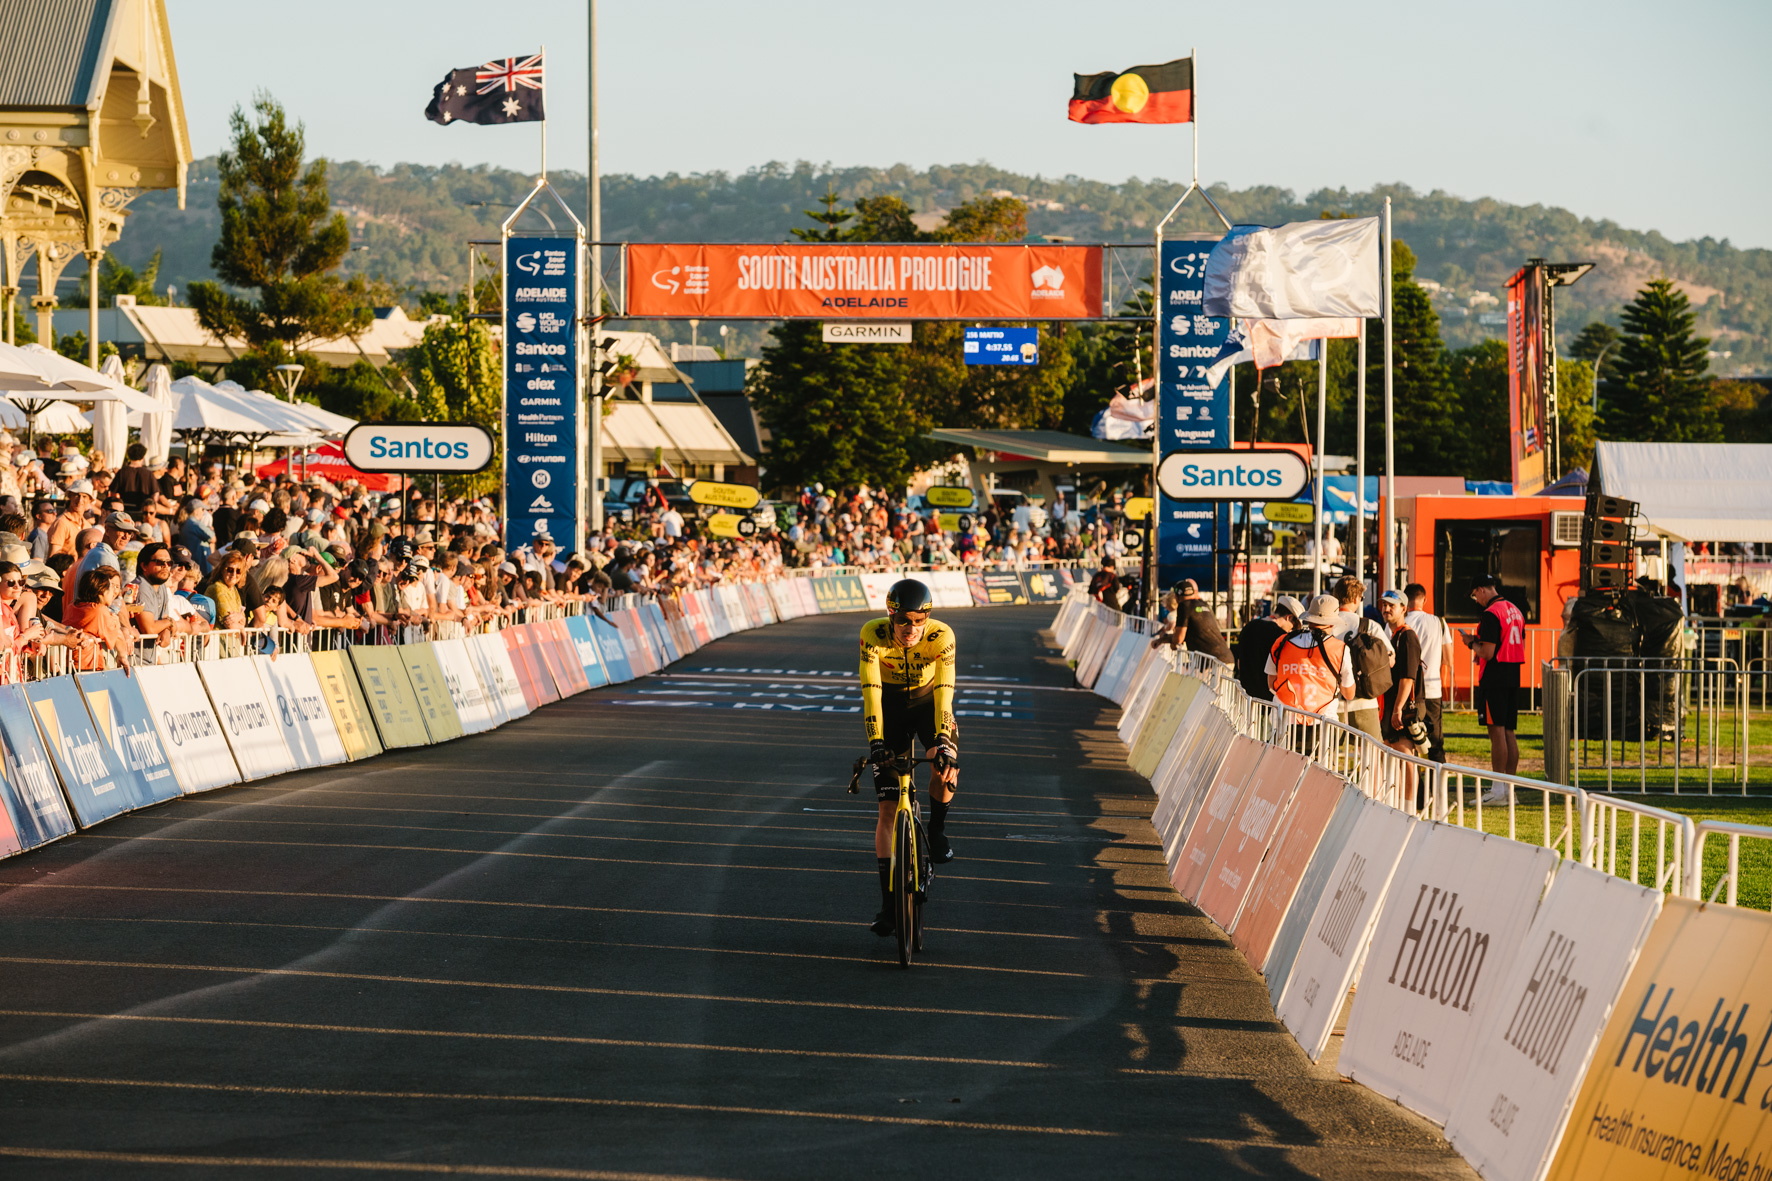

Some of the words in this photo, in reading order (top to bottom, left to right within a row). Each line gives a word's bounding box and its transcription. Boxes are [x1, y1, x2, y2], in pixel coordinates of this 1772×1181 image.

[737, 255, 797, 291] SOUTH
[801, 255, 896, 291] AUSTRALIA
[901, 256, 993, 292] PROLOGUE
[515, 288, 567, 298] ADELAIDE
[1170, 290, 1202, 300] ADELA
[822, 298, 909, 308] ADELAIDE
[539, 312, 555, 320] UCI
[539, 319, 566, 327] WORLD
[1194, 321, 1220, 330] WORLD
[540, 326, 560, 334] TOUR
[830, 326, 904, 338] GARMIN
[516, 342, 567, 356] Santos
[1170, 345, 1220, 358] Santos
[520, 398, 562, 406] GARMIN
[518, 413, 538, 421] Health
[525, 432, 558, 443] Hilton
[1174, 429, 1215, 440] Vanguard
[370, 436, 469, 459] Santos
[1182, 464, 1282, 487] Santos
[713, 487, 736, 495] SOUTH
[1184, 544, 1212, 552] YAMAHA
[898, 662, 931, 670] VISMA
[1282, 663, 1327, 678] PRESS
[291, 696, 326, 721] HYUNDAI
[232, 702, 270, 730] HYUNDAI
[175, 710, 217, 740] HYUNDAI
[1238, 778, 1286, 853] Vanguard
[1317, 852, 1368, 958] Hilton
[1388, 883, 1490, 1013] Hilton
[1504, 930, 1588, 1076] Hilton
[1614, 982, 1750, 1099] Health
[1392, 1029, 1432, 1070] ADELAIDE
[1587, 1101, 1634, 1147] Health
[1630, 1114, 1702, 1172] insurance.
[1702, 1138, 1750, 1181] Made
